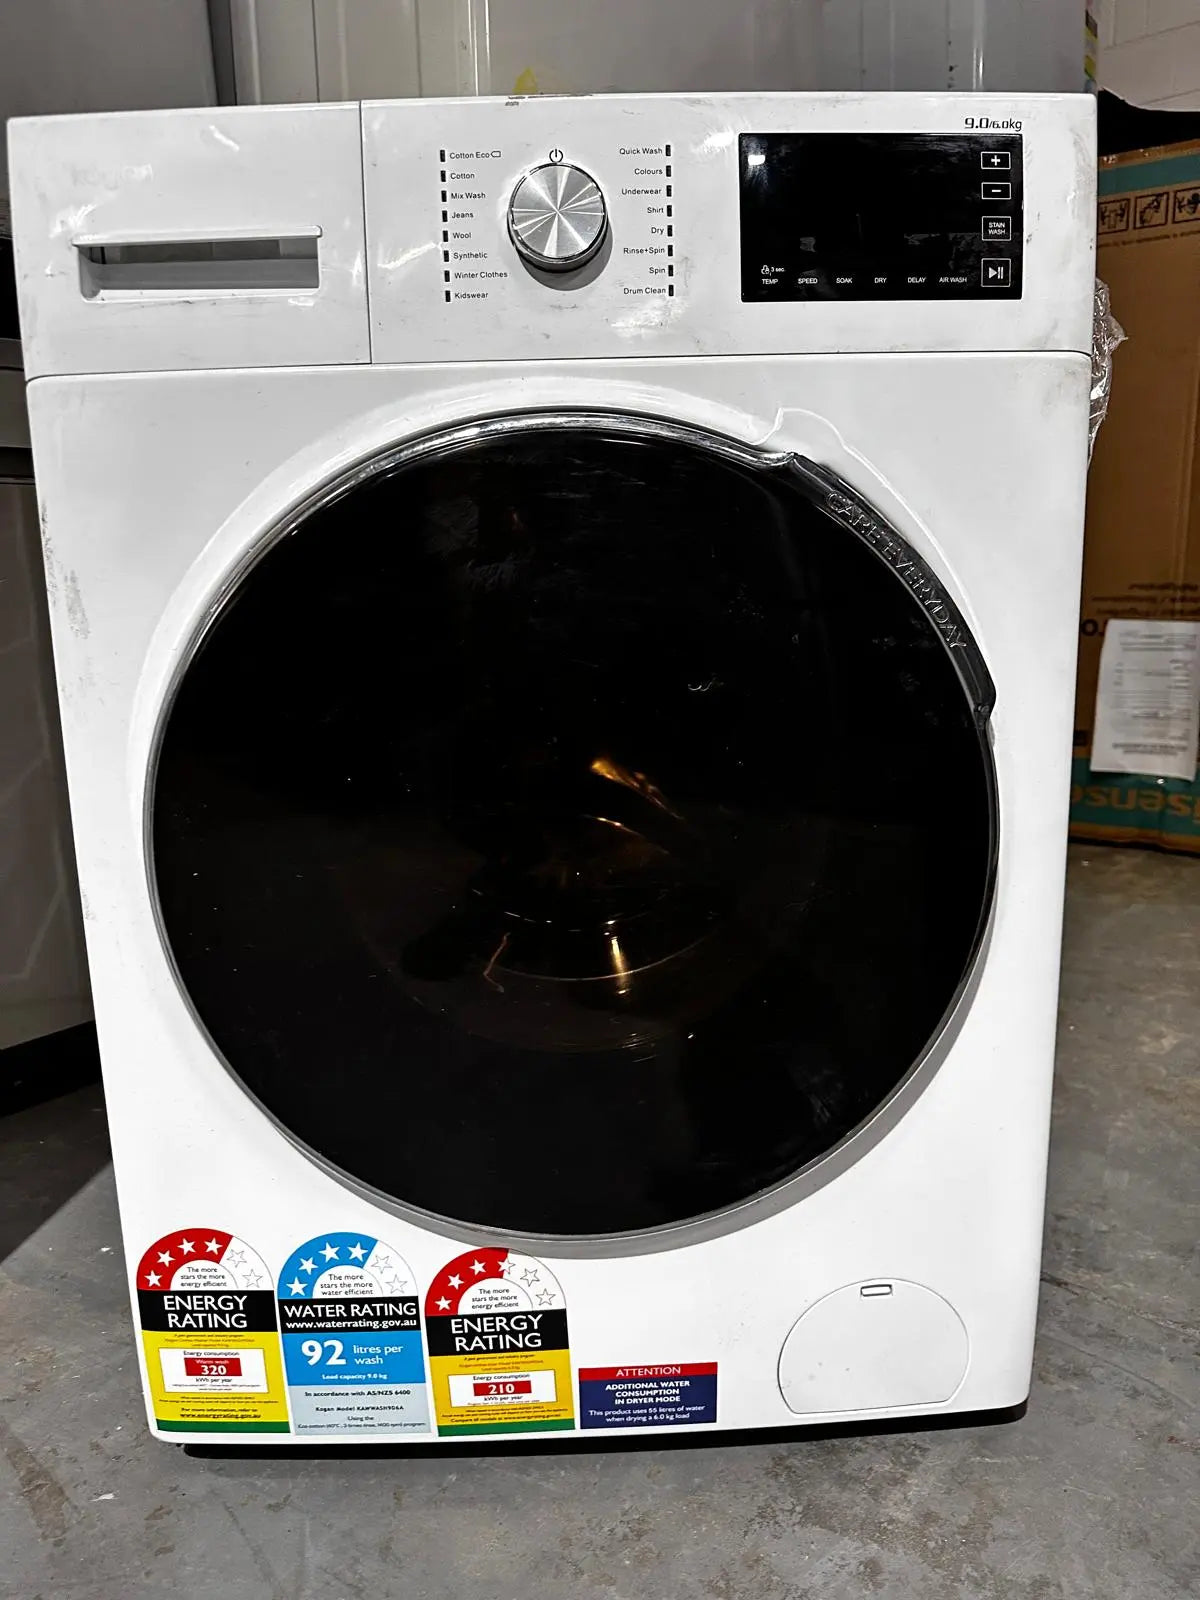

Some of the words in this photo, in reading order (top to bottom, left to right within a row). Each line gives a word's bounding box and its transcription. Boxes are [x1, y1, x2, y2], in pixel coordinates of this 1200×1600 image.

[651, 227, 664, 235] Dry
[454, 252, 488, 260] Synthetic
[163, 1295, 248, 1310] ENERGY
[284, 1305, 347, 1318] WATER
[350, 1303, 417, 1317] RATING
[168, 1313, 248, 1328] RATING
[286, 1319, 417, 1329] www.waterrating.gov.au
[450, 1314, 543, 1334] ENERGY
[455, 1333, 542, 1352] RATING
[301, 1340, 347, 1366] 92
[353, 1345, 381, 1354] litres
[384, 1346, 403, 1356] per
[354, 1356, 383, 1365] wash
[201, 1365, 227, 1375] 320
[616, 1366, 681, 1377] ATTENTION
[488, 1383, 515, 1394] 210
[660, 1380, 690, 1388] WATER
[615, 1389, 679, 1398] CONSUMPTION
